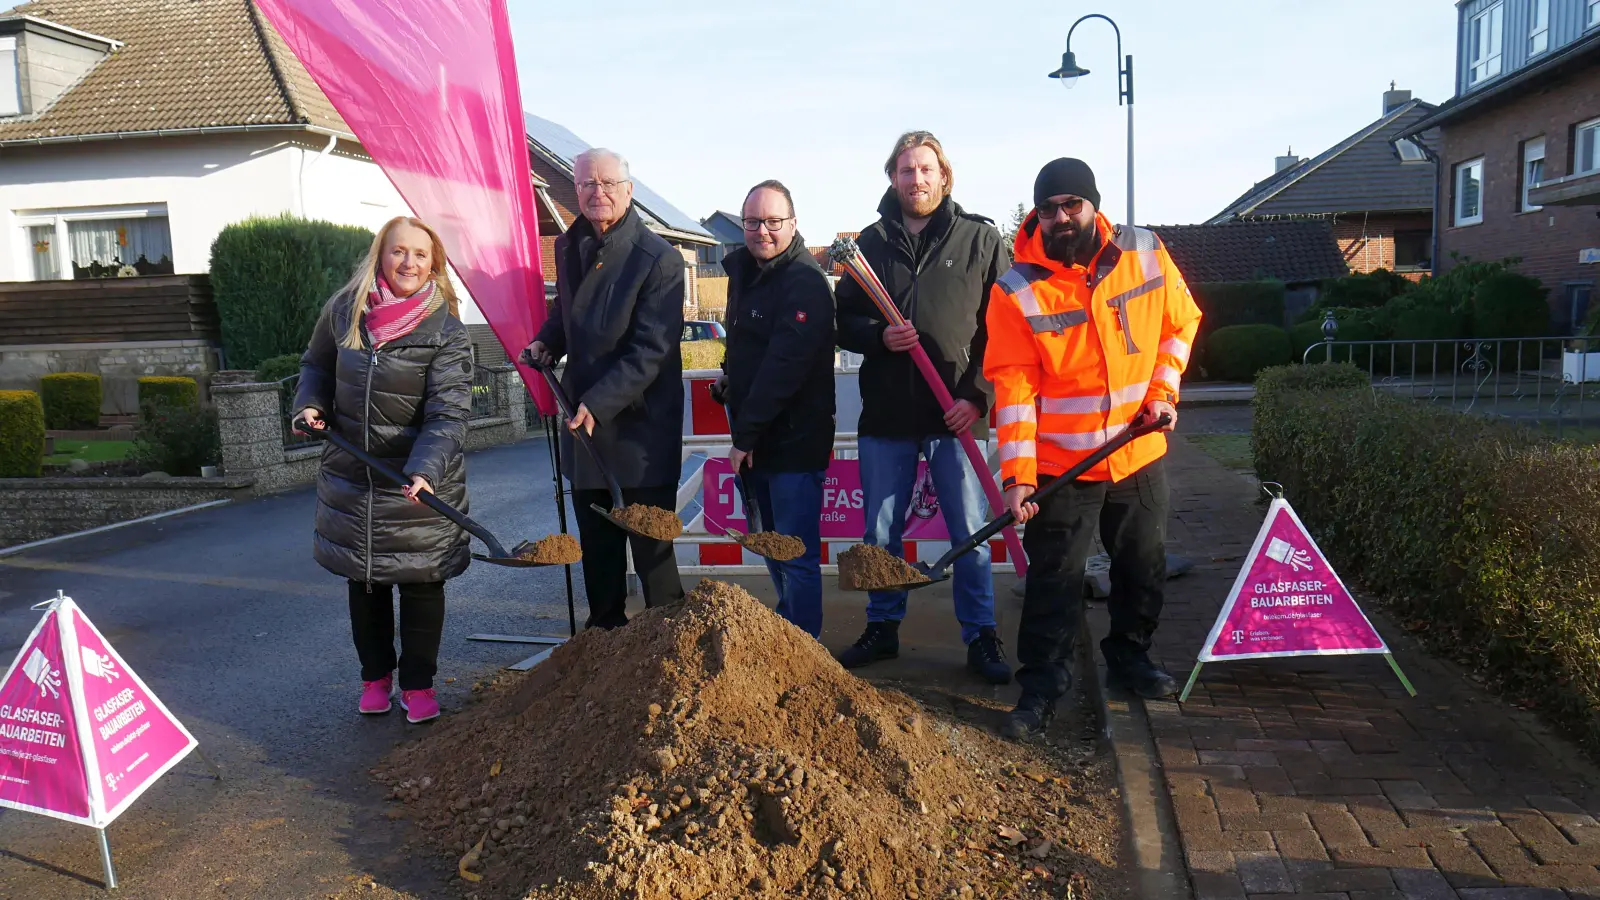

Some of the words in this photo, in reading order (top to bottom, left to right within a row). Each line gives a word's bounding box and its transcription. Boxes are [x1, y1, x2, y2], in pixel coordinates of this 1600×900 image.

[822, 477, 839, 486] en
[823, 488, 864, 509] FAS
[820, 510, 846, 522] raße
[1254, 580, 1328, 594] GLASFASER-
[1250, 594, 1333, 608] BAUARBEITEN
[93, 687, 135, 722] GLASFASER-
[0, 704, 65, 728] GLASFASER-
[98, 699, 147, 741] BAUARBEITEN
